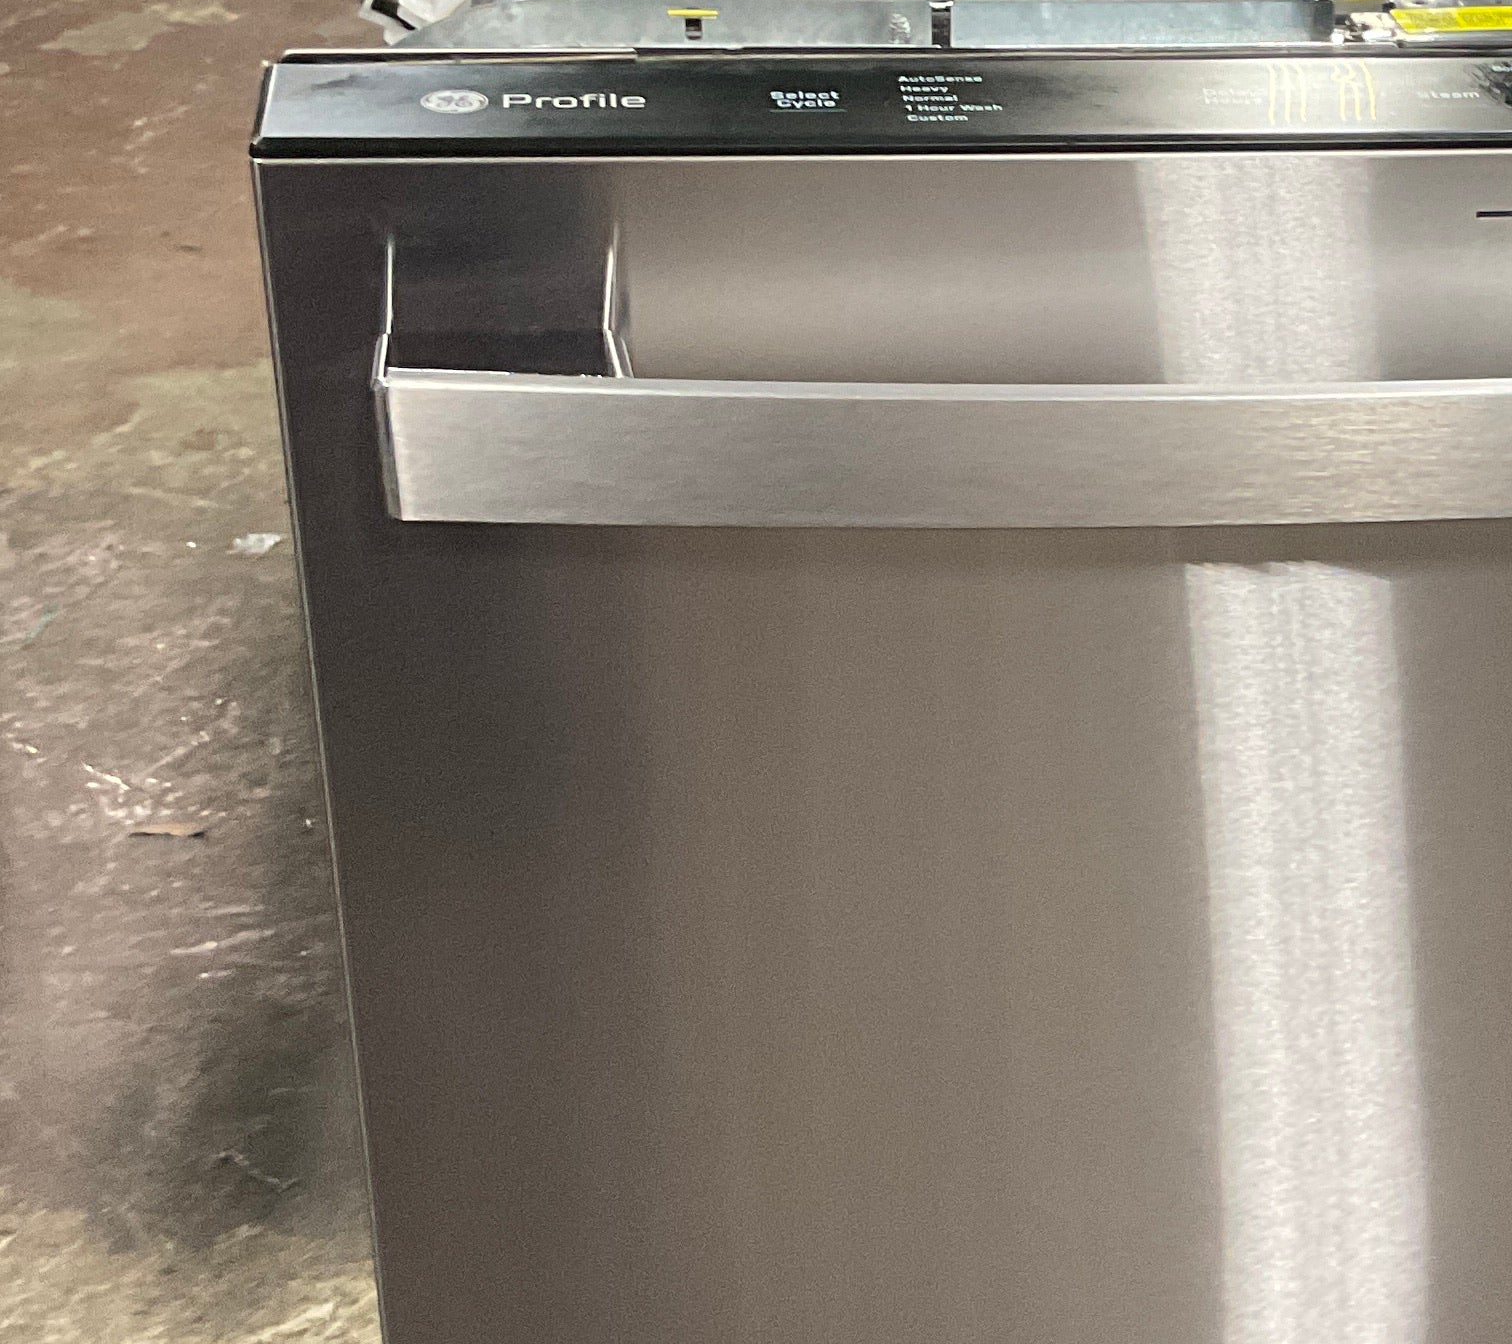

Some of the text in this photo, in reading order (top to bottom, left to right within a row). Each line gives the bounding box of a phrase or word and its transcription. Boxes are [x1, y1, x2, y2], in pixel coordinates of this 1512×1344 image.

[898, 75, 983, 83] AutoSense
[900, 85, 950, 93] Heavy
[770, 90, 840, 100] Select
[902, 94, 959, 102] Normal
[502, 93, 647, 109] Profile
[776, 99, 836, 109] Cycle
[917, 104, 956, 112] Hour
[959, 104, 1004, 112] Wash
